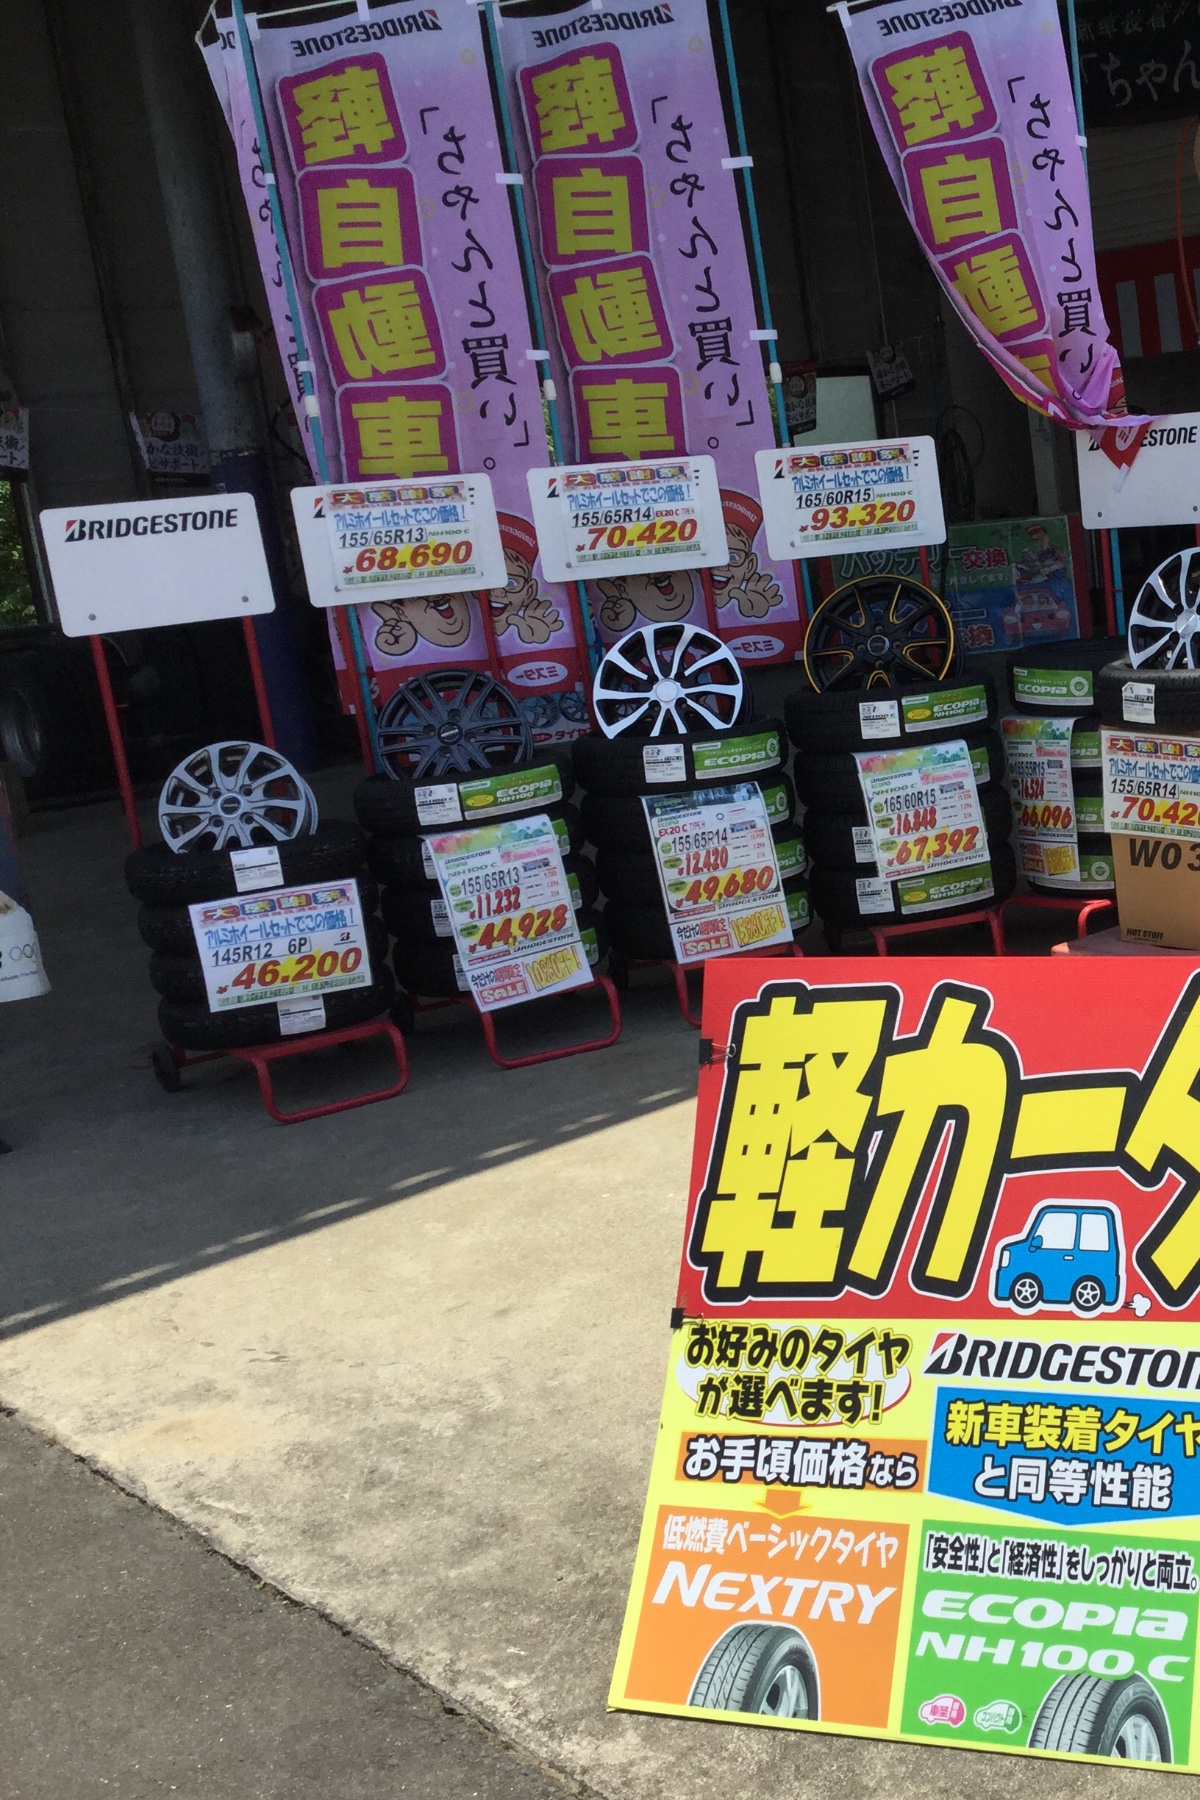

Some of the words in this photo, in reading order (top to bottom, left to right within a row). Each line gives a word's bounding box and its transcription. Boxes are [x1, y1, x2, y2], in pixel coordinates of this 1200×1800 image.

[796, 488, 871, 509] 165/60R15
[65, 508, 238, 543] BRIDGESTONE
[572, 507, 651, 528] 155/65R14
[339, 527, 425, 548] 155/65R13
[556, 727, 590, 742] タイヤ
[884, 789, 936, 813] 165/60R15
[1110, 778, 1177, 798] 155/65R14
[671, 827, 728, 854] 155/65R14
[461, 867, 520, 896] 155/65R13
[212, 941, 273, 966] 145R12
[288, 936, 308, 954] 6P
[685, 1323, 912, 1376] お好みのタイヤ
[697, 1374, 886, 1425] が選べます!
[684, 1437, 918, 1488] お手頃価格なら
[973, 1454, 1173, 1511] と同等性能
[664, 1515, 898, 1569] 低燃費ベーシックタイヤ
[923, 1533, 1200, 1593] 「安全性」と「経済性」をしっかりと両立。
[652, 1561, 897, 1625] NEXTRY
[915, 1631, 1135, 1678] NH100
[1148, 1654, 1191, 1683] C
